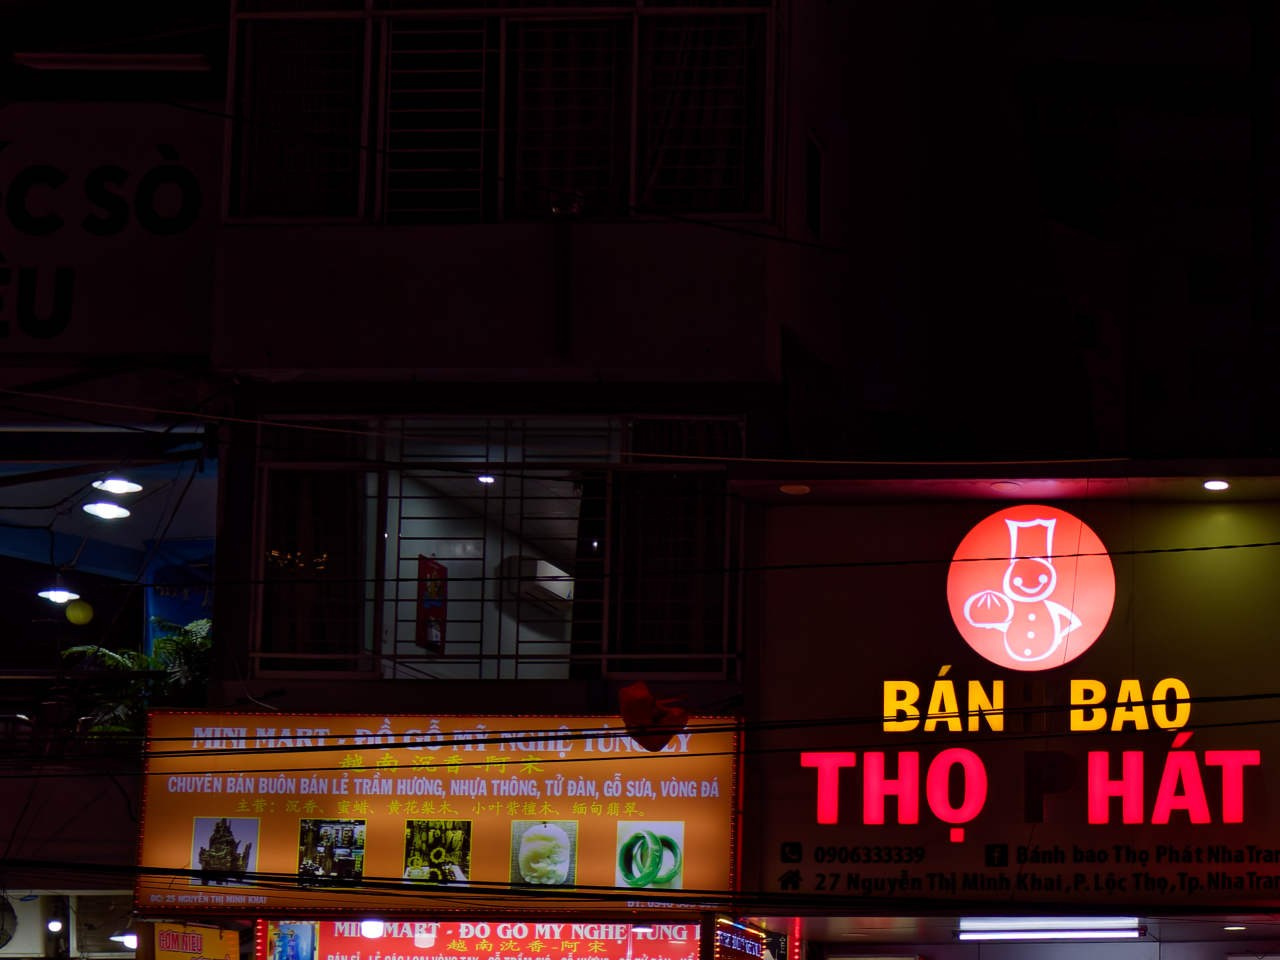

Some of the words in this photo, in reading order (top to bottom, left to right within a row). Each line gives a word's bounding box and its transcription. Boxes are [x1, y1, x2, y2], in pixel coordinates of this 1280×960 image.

[82, 144, 201, 236] SÒ
[1070, 677, 1191, 732] BAO
[192, 727, 248, 750] MINI
[256, 727, 329, 749] MART
[167, 773, 223, 794] CHUYÊN
[226, 774, 254, 795] BÁN
[258, 773, 296, 795] BUÔN
[300, 773, 328, 796] BÁN
[332, 772, 349, 796] LẺ
[354, 771, 392, 796] TRẦM
[491, 776, 541, 799] THÔNG,
[661, 777, 697, 798] VÒNG
[700, 776, 720, 799] ĐÁ
[801, 747, 988, 843] THỌ
[813, 845, 925, 865] 0906333339
[1016, 844, 1065, 865] Bánh
[1072, 844, 1108, 865] bao
[1112, 844, 1147, 869] Thọ
[1155, 844, 1204, 865] Phát
[814, 873, 840, 892] 27
[926, 873, 956, 896] Thị
[962, 872, 1010, 892] Minh
